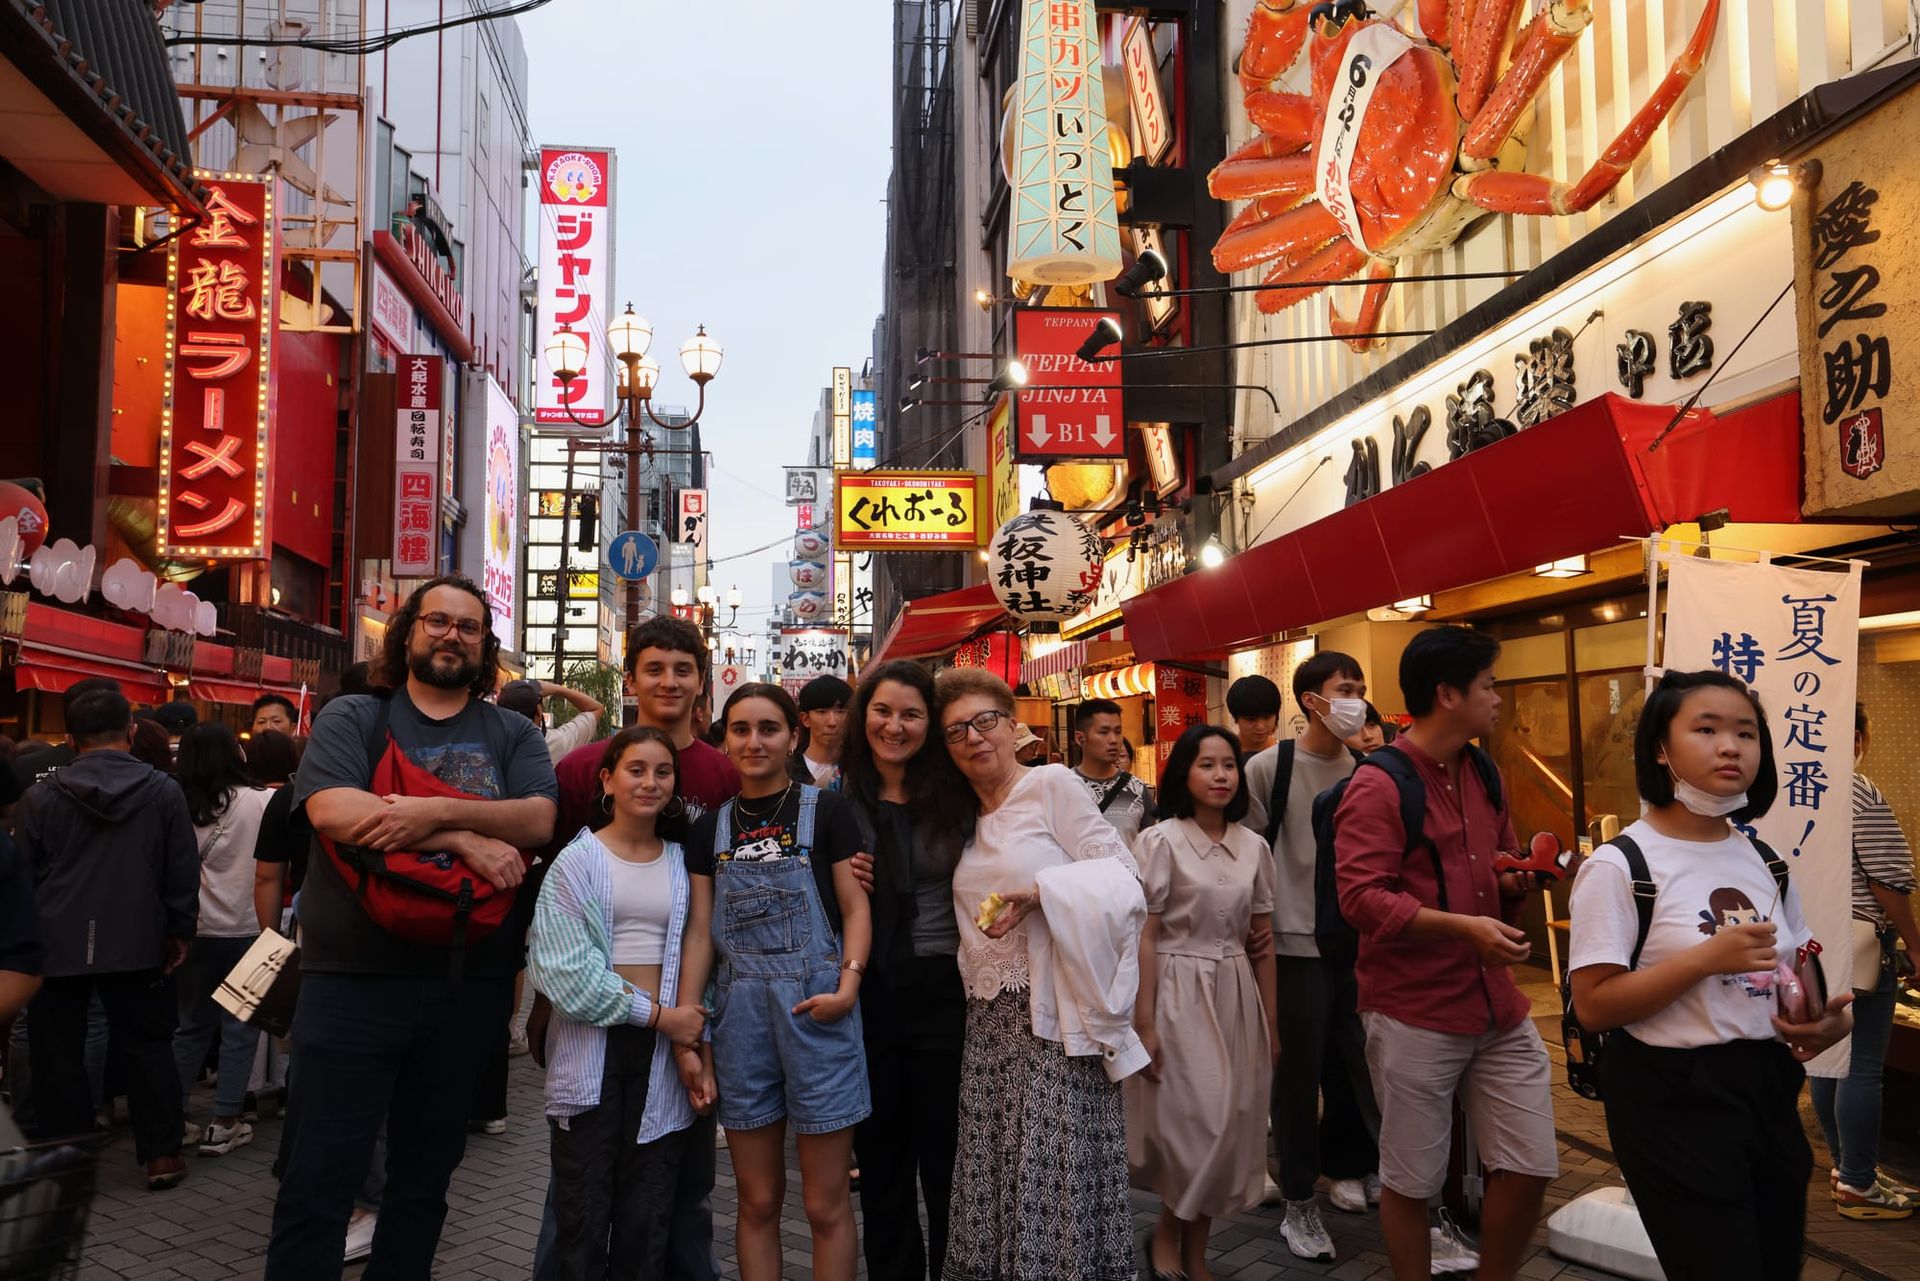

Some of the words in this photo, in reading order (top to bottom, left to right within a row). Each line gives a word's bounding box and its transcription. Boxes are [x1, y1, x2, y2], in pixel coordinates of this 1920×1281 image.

[1051, 2, 1085, 251] 串カツいっとく
[174, 185, 258, 537] 金龍ラーメン
[1022, 353, 1115, 373] TEPPAN
[1021, 385, 1108, 403] JINJYA
[410, 411, 426, 460] 回転寿司
[853, 401, 875, 449] 焼肉
[1058, 423, 1085, 442] B1
[848, 489, 967, 530] くれおーる
[997, 513, 1058, 614] 鉄板神社
[782, 645, 846, 671] わなか
